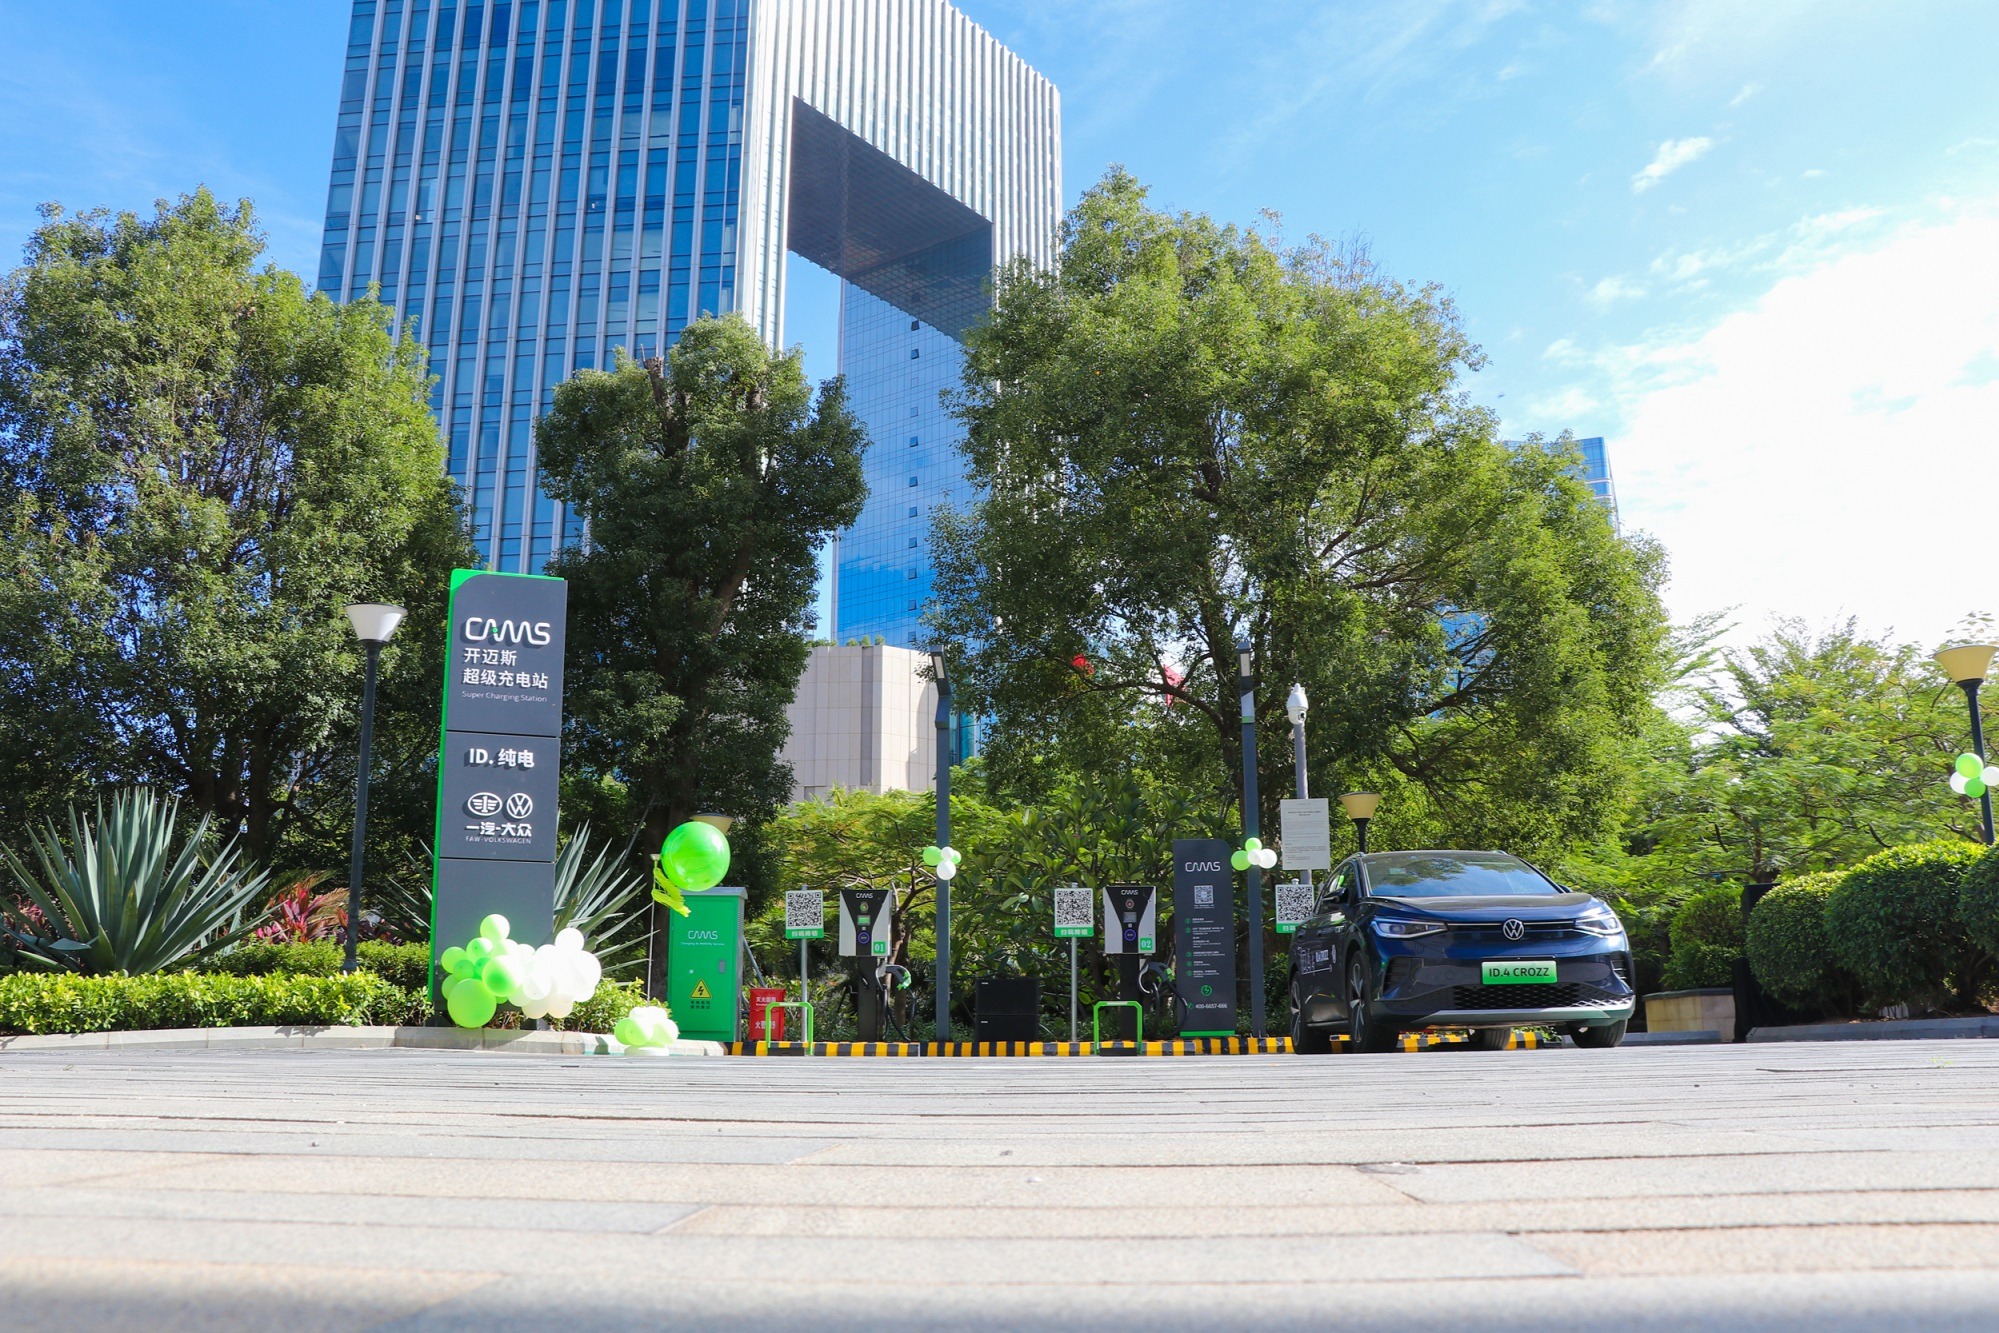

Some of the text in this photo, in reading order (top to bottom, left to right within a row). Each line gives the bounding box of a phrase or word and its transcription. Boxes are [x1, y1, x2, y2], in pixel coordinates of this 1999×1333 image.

[464, 616, 552, 646] CAMS
[463, 647, 518, 667] 开迈斯
[462, 668, 549, 690] 超级充电站
[462, 690, 548, 703] Super Charging Station
[469, 748, 535, 769] ID. 纯电
[465, 821, 533, 837] 一汽-大众
[465, 835, 532, 845] FAW-VOLKSWAGEN
[1185, 861, 1221, 873] CAMS
[688, 930, 719, 940] CAMS
[874, 943, 884, 952] 01
[1141, 940, 1151, 948] 02
[1489, 967, 1550, 977] ID.4 CROZZ
